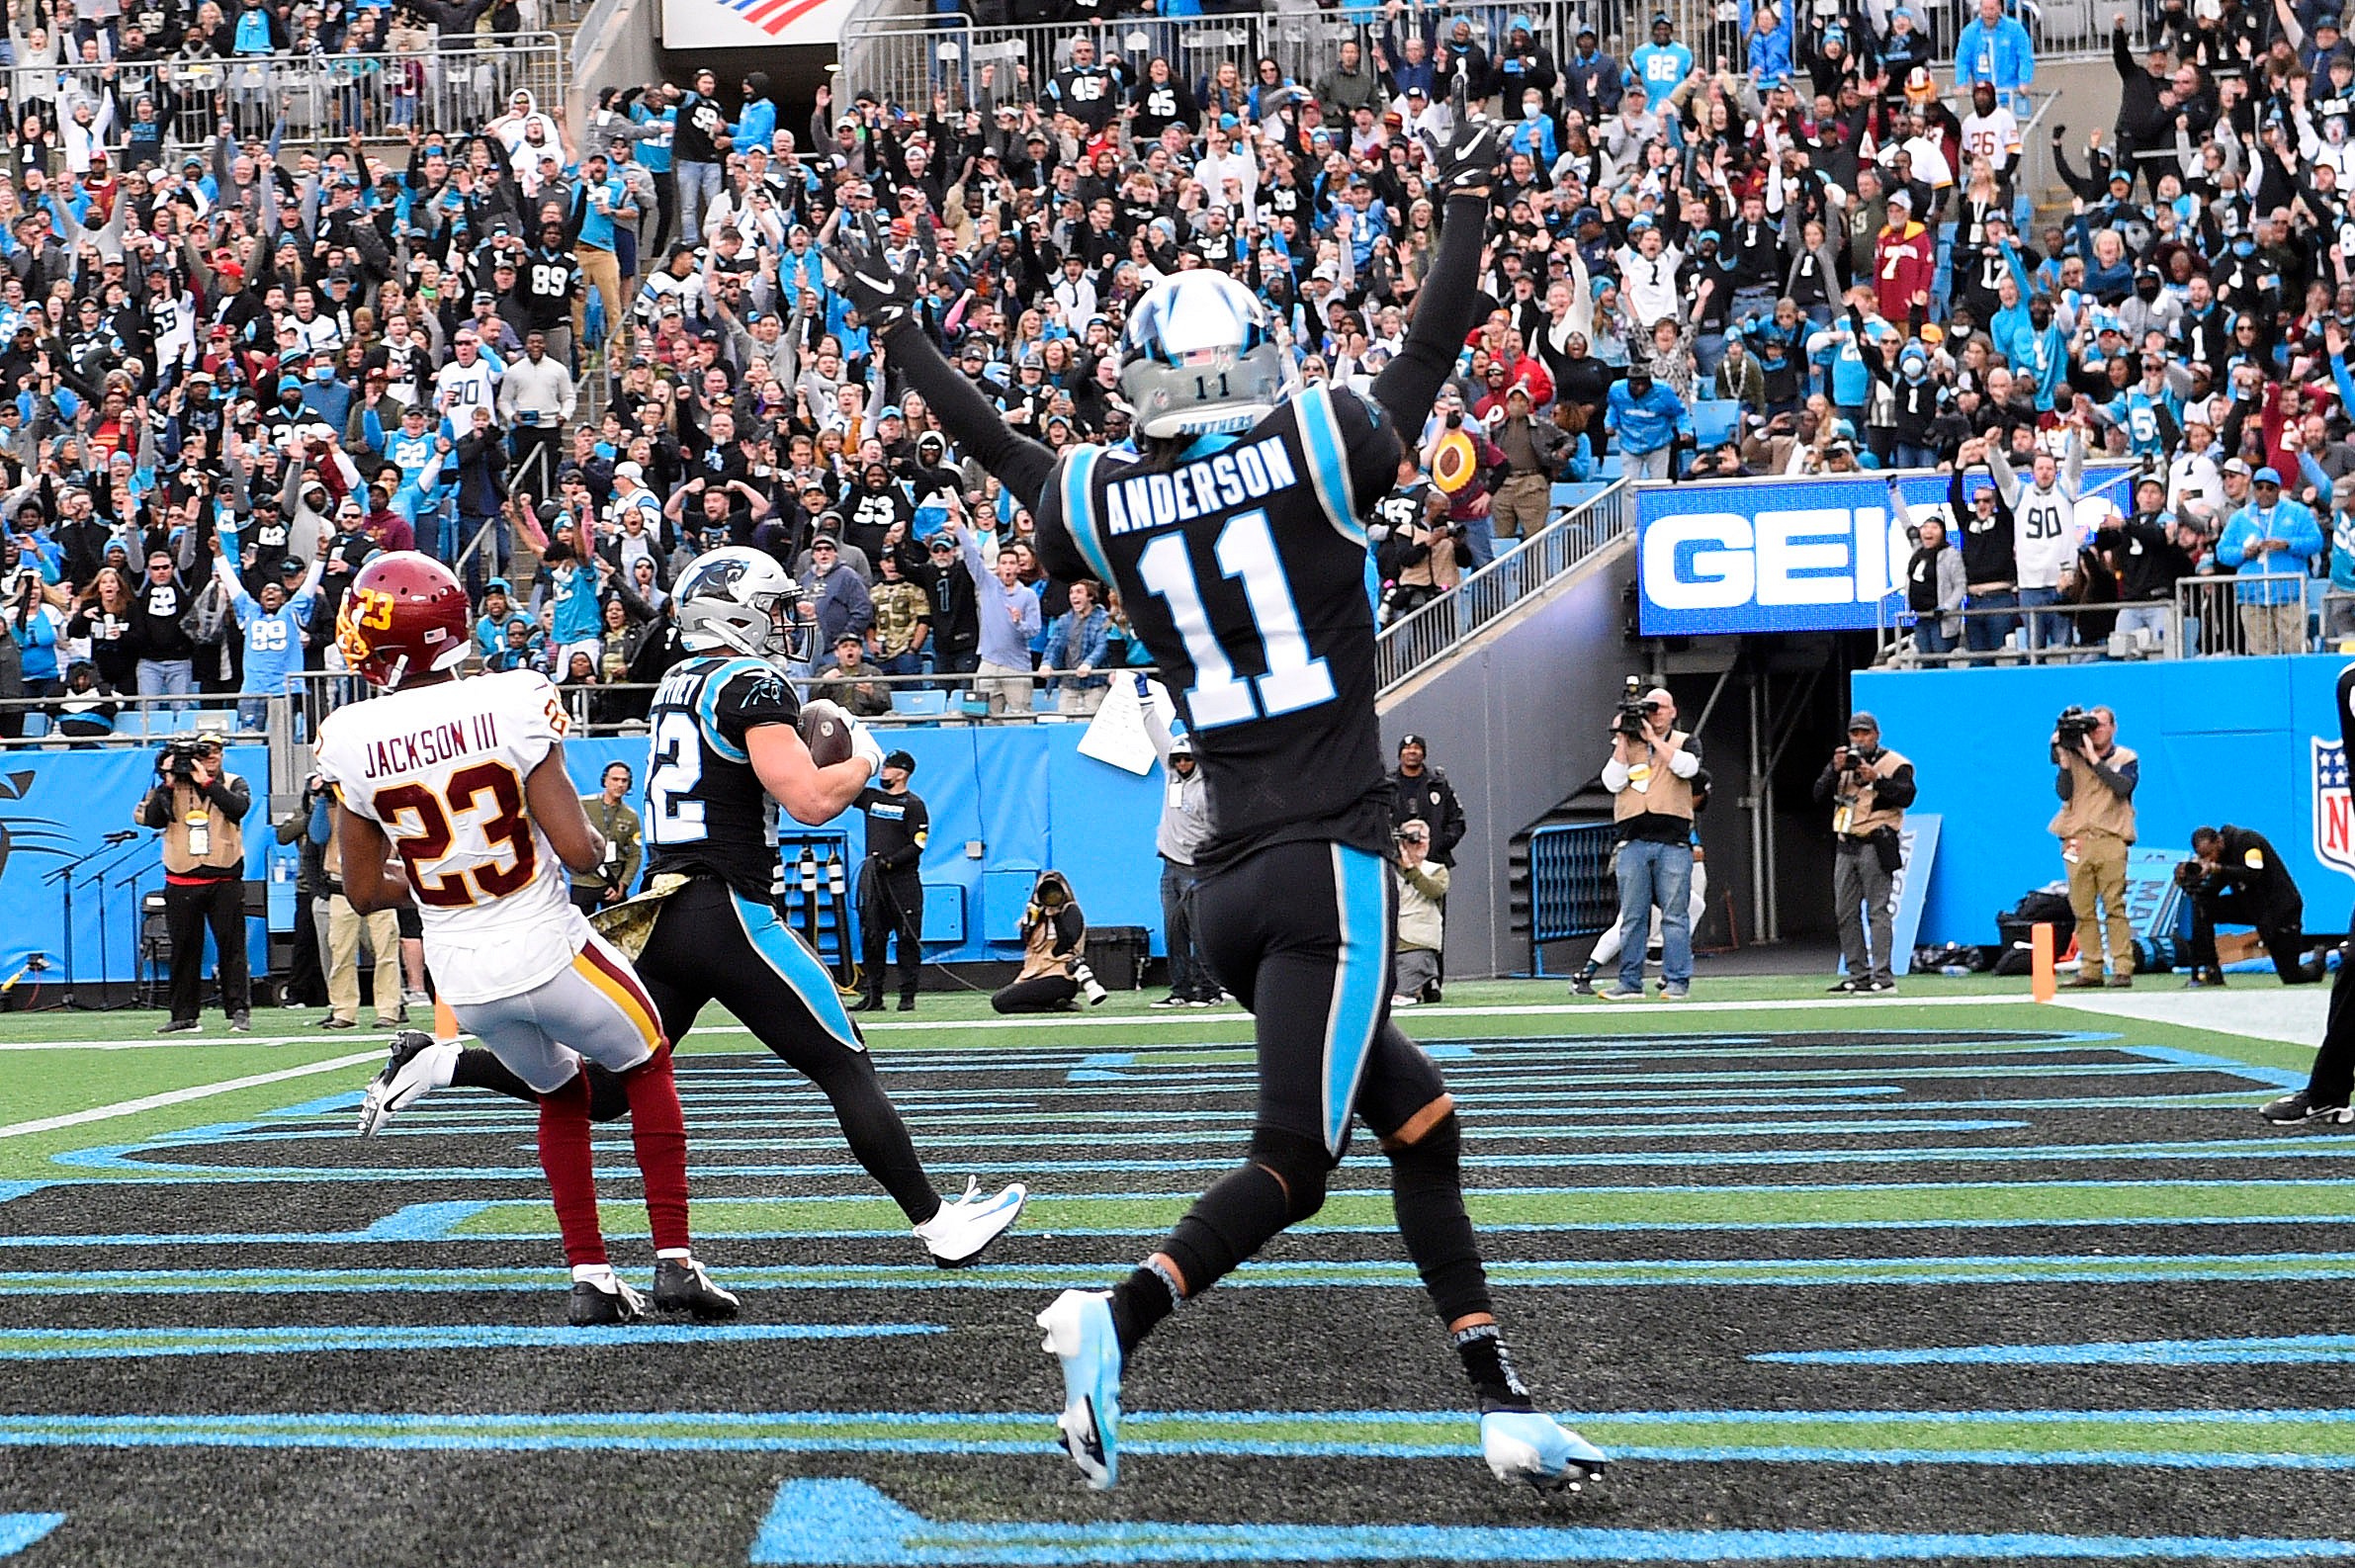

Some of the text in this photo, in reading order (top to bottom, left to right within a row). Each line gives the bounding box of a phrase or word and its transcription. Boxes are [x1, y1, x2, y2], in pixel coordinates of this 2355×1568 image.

[1646, 55, 1678, 81] 82
[1070, 76, 1100, 101] 45
[1147, 89, 1177, 117] 45
[1970, 131, 1995, 156] 26
[532, 264, 568, 296] 89
[2191, 326, 2206, 360] 1
[1195, 372, 1230, 400] 11
[394, 443, 426, 468] 22
[1106, 435, 1298, 536] ANDERSON
[852, 496, 895, 525] 53
[2026, 506, 2062, 539] 90
[147, 586, 178, 617] 22
[359, 587, 394, 631] 23
[1137, 507, 1339, 731] 11
[365, 712, 498, 779] JACKSON III
[373, 758, 538, 909] 23
